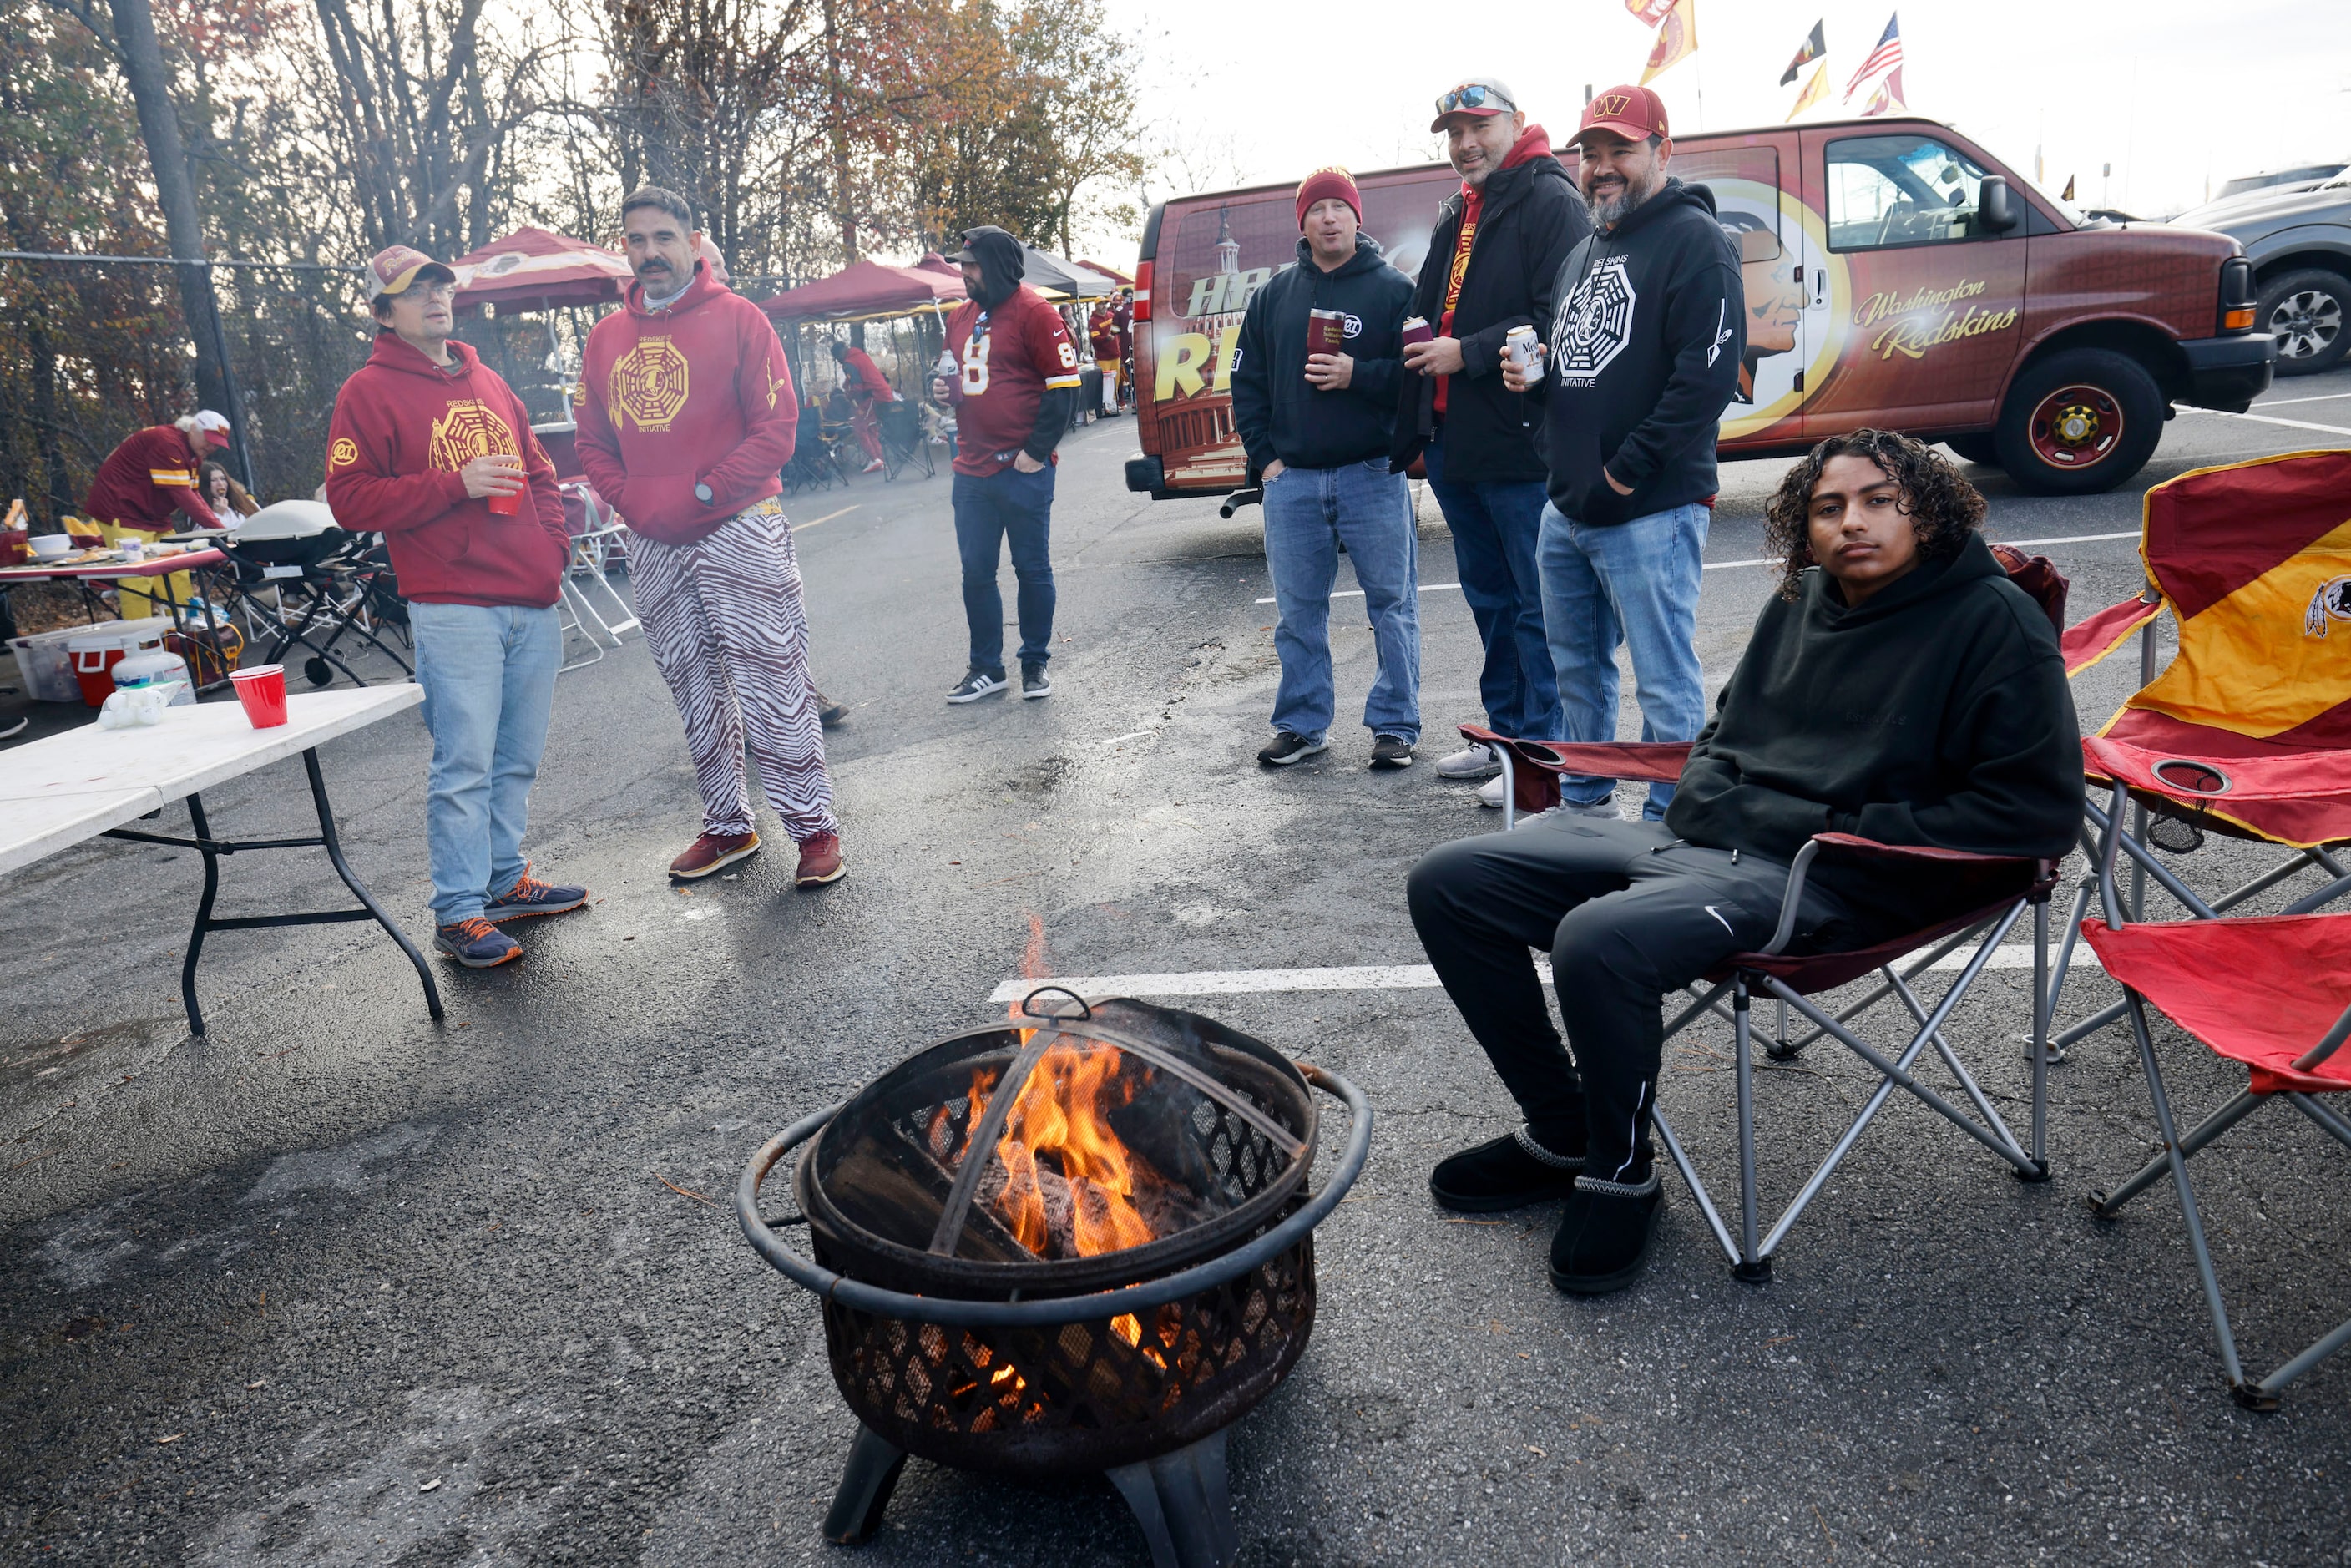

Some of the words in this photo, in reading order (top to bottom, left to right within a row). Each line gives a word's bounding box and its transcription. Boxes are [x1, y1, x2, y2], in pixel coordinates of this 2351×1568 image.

[1593, 94, 1631, 118] W
[1853, 278, 1985, 327] Washington
[1056, 342, 1076, 369] 8
[1871, 305, 2017, 360] Redskins
[962, 333, 992, 396] 8
